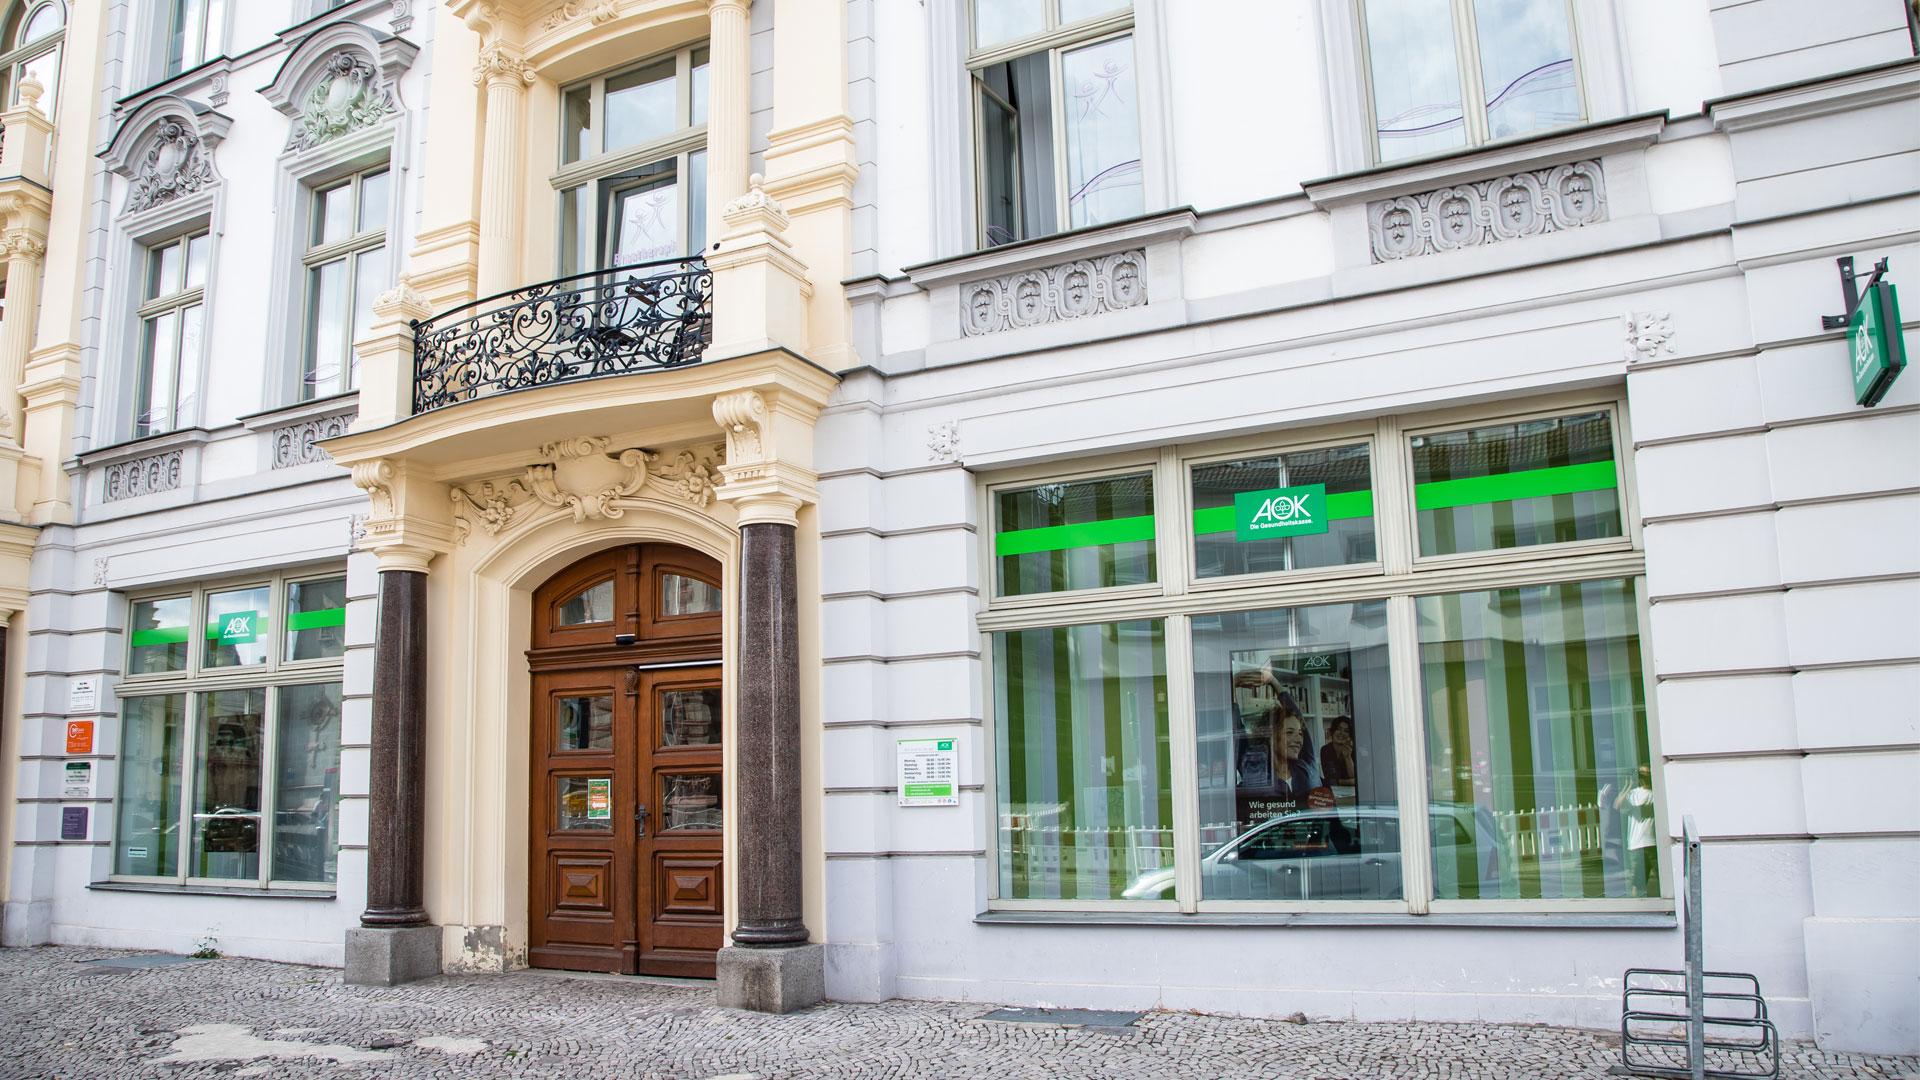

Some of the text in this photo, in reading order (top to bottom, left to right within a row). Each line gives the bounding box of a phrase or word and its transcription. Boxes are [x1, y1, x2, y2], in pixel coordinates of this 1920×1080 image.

[1855, 314, 1873, 374] AOK
[1251, 494, 1312, 523] AOK
[223, 616, 250, 635] AOK
[1304, 656, 1331, 667] AOK
[1249, 800, 1296, 812] Wie gesund
[1249, 810, 1283, 819] arbeiten
